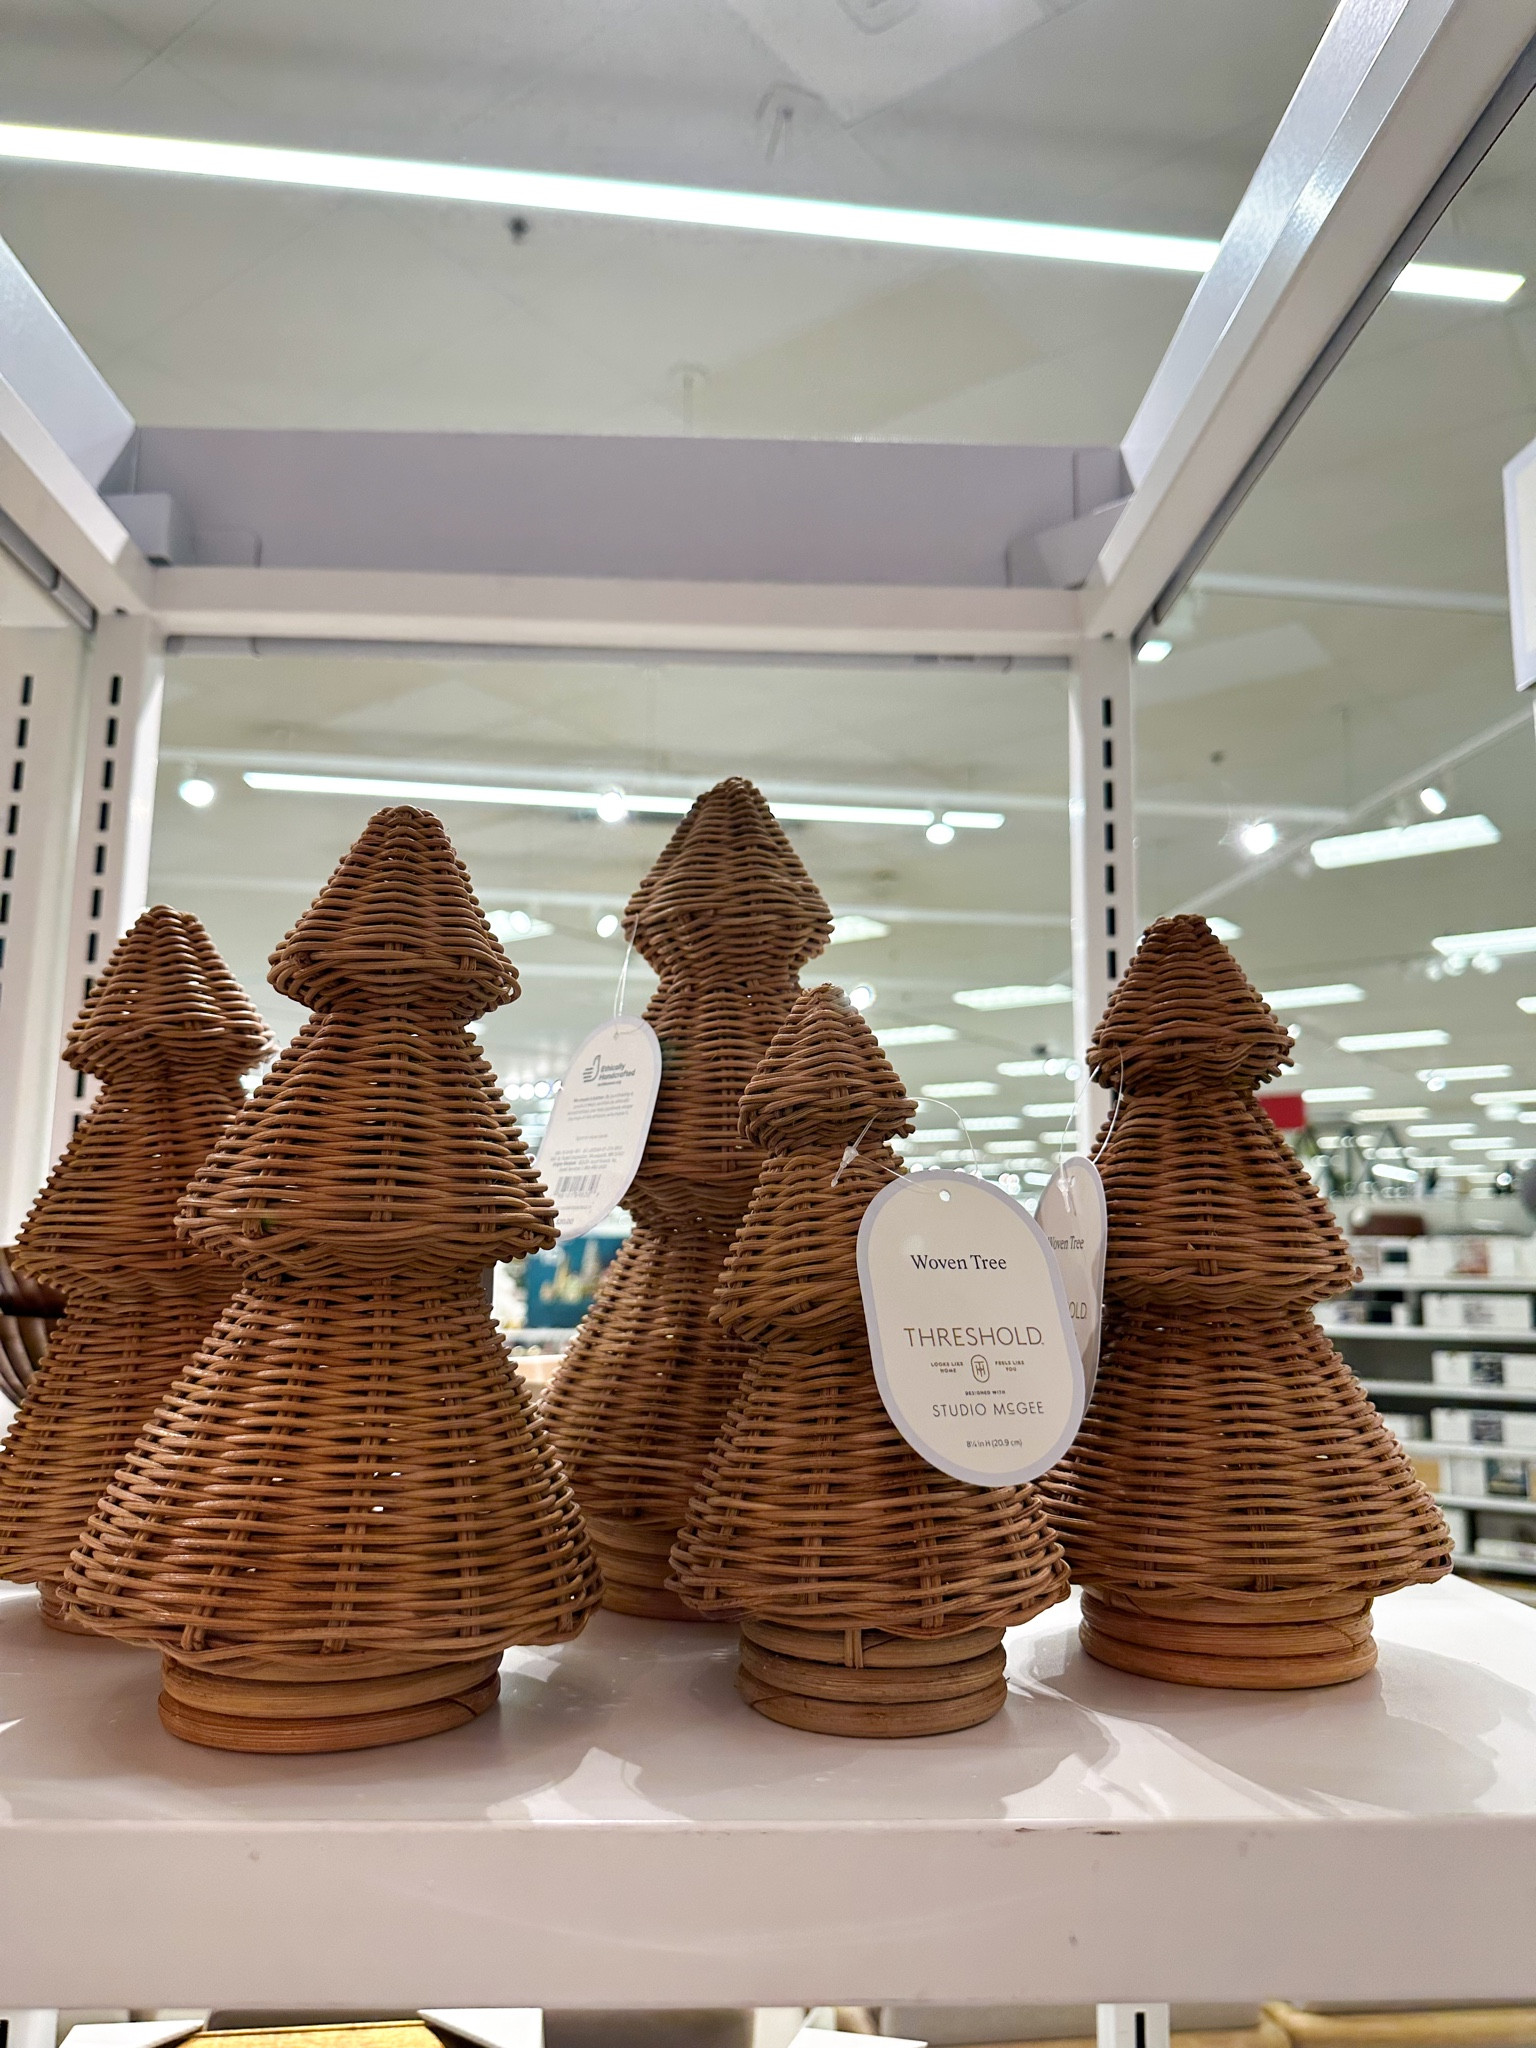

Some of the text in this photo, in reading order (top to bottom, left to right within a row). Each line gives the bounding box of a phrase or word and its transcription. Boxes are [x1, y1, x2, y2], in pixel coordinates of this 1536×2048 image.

[599, 1069, 636, 1080] Handcrafted
[601, 1063, 626, 1073] Ethically
[1070, 1235, 1084, 1249] Tree
[910, 1254, 1007, 1270] Woven Tree
[932, 1403, 987, 1417] STUDIO
